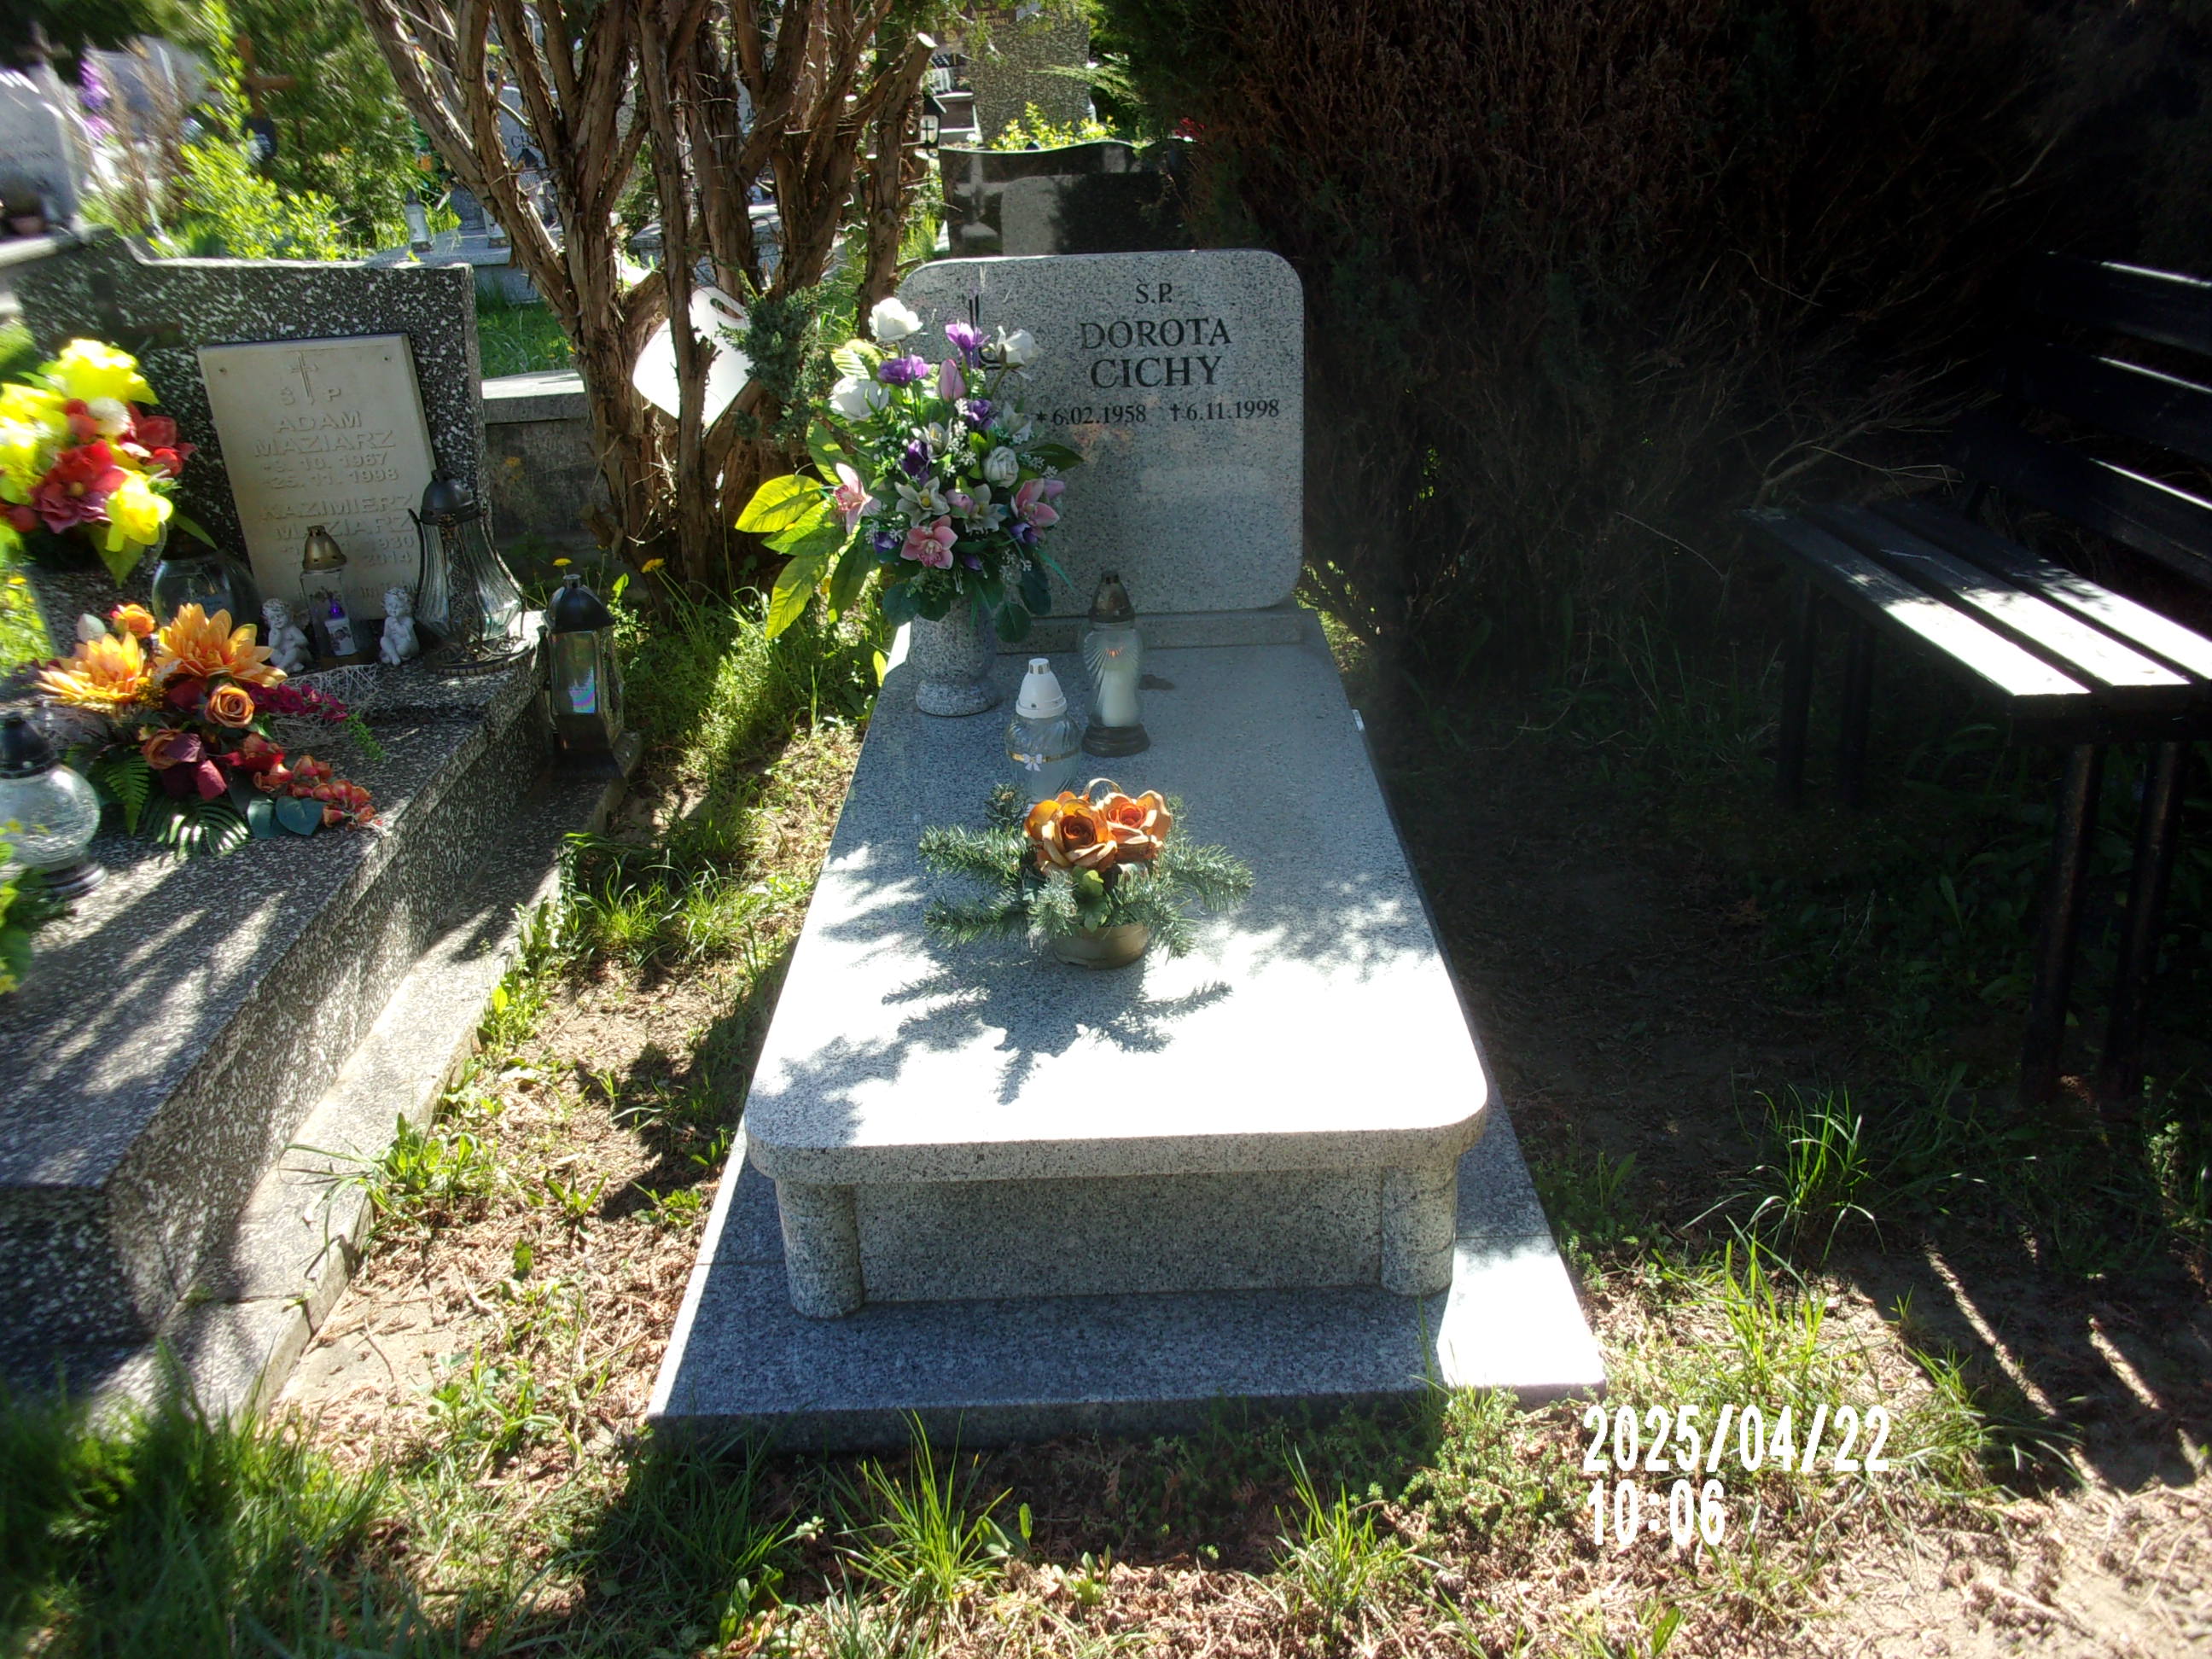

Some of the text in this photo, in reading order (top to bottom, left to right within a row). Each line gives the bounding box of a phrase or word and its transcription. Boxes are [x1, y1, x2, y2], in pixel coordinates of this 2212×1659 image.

[1079, 317, 1232, 351] DOROTA
[1090, 355, 1223, 389] CICHY
[277, 410, 362, 434] ADAM
[255, 429, 397, 458] MAZIARZ
[259, 492, 415, 521] KAZIMIERZ
